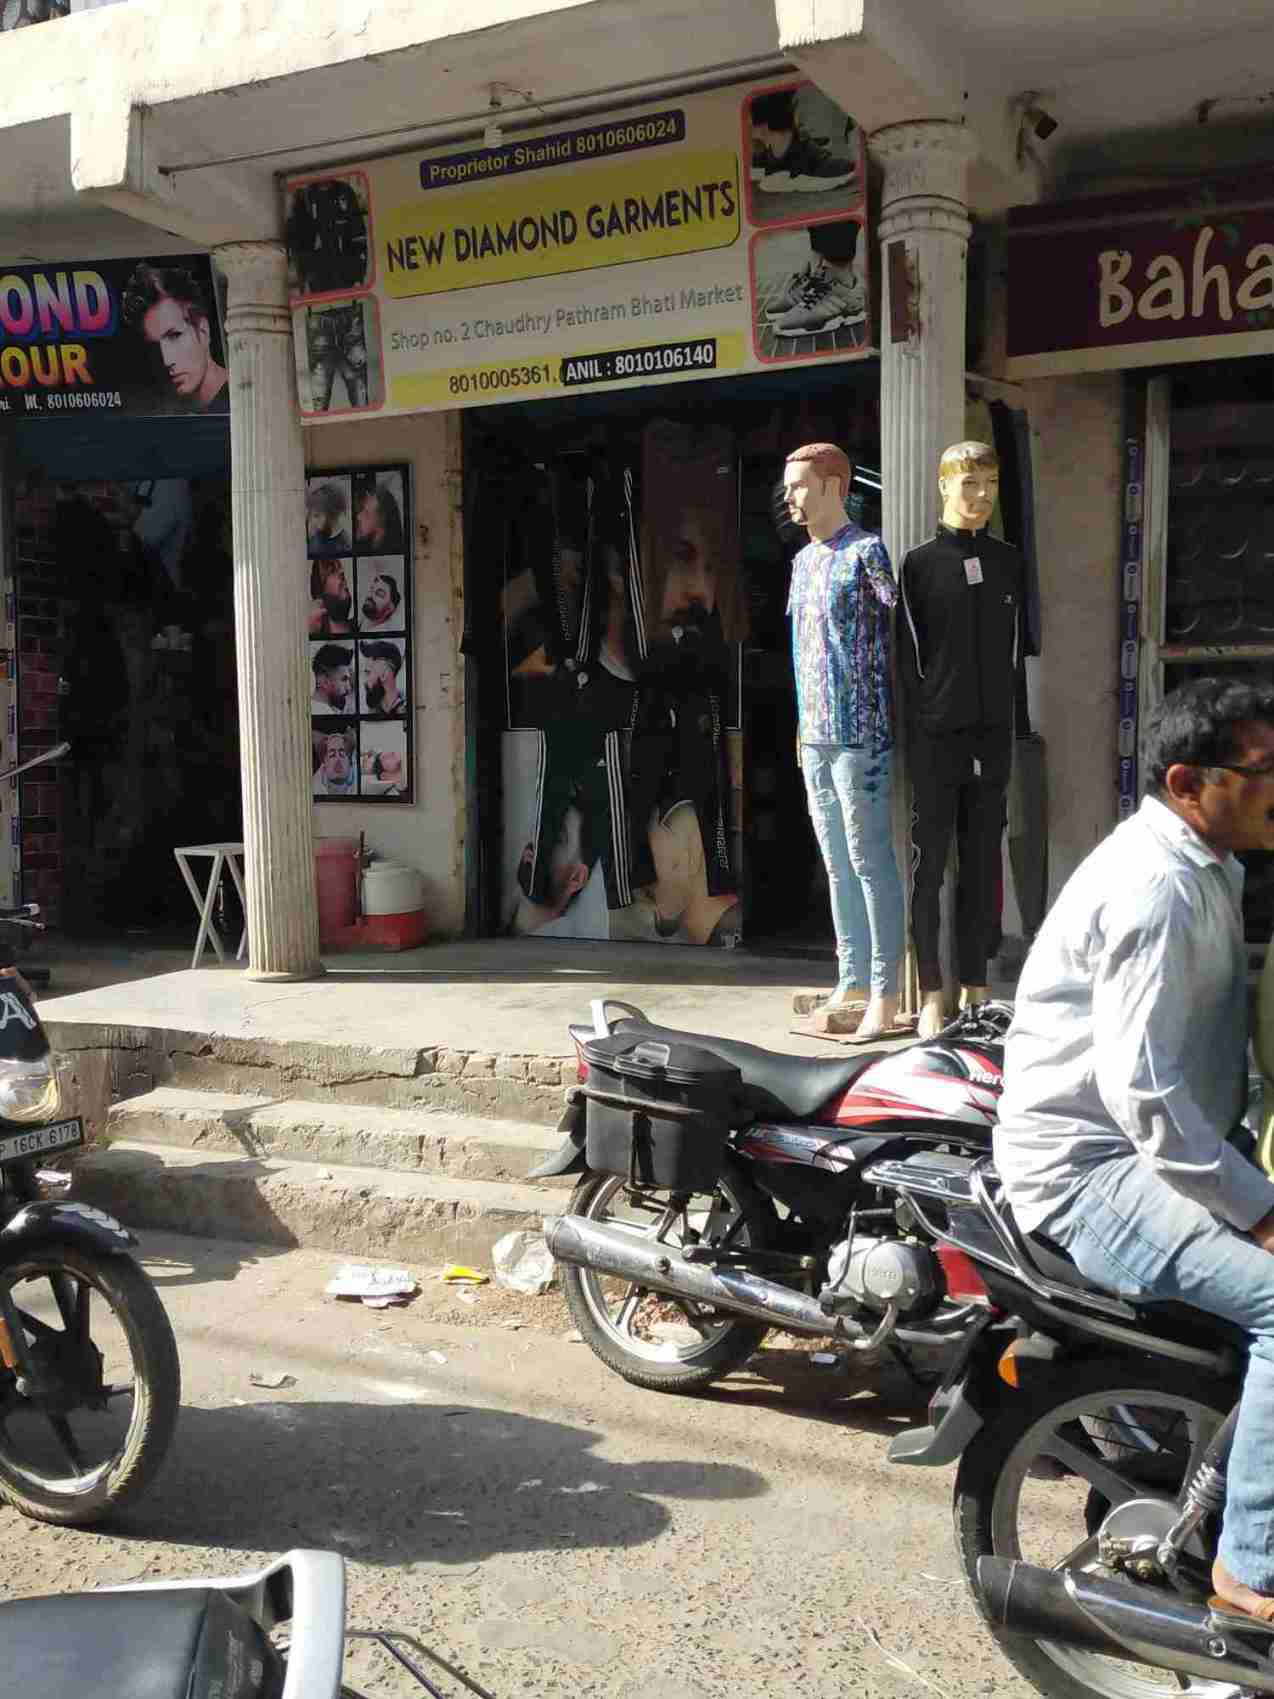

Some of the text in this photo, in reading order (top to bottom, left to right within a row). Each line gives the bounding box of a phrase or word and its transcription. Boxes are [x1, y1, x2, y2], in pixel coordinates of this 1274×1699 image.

[429, 118, 677, 181] Proprietor Shahid 8010606024
[387, 180, 736, 273] NEW DIAMOND GARMENTS
[391, 331, 429, 352] Shop
[434, 329, 457, 345] no.
[461, 323, 471, 341] 2
[473, 312, 552, 339] Chaudhry
[555, 303, 627, 328] Pathram
[679, 283, 744, 310] Market
[0, 344, 92, 386] OUR
[566, 359, 602, 382] ANIL
[614, 342, 714, 374] 8010106140
[47, 391, 121, 409] 8010606024
